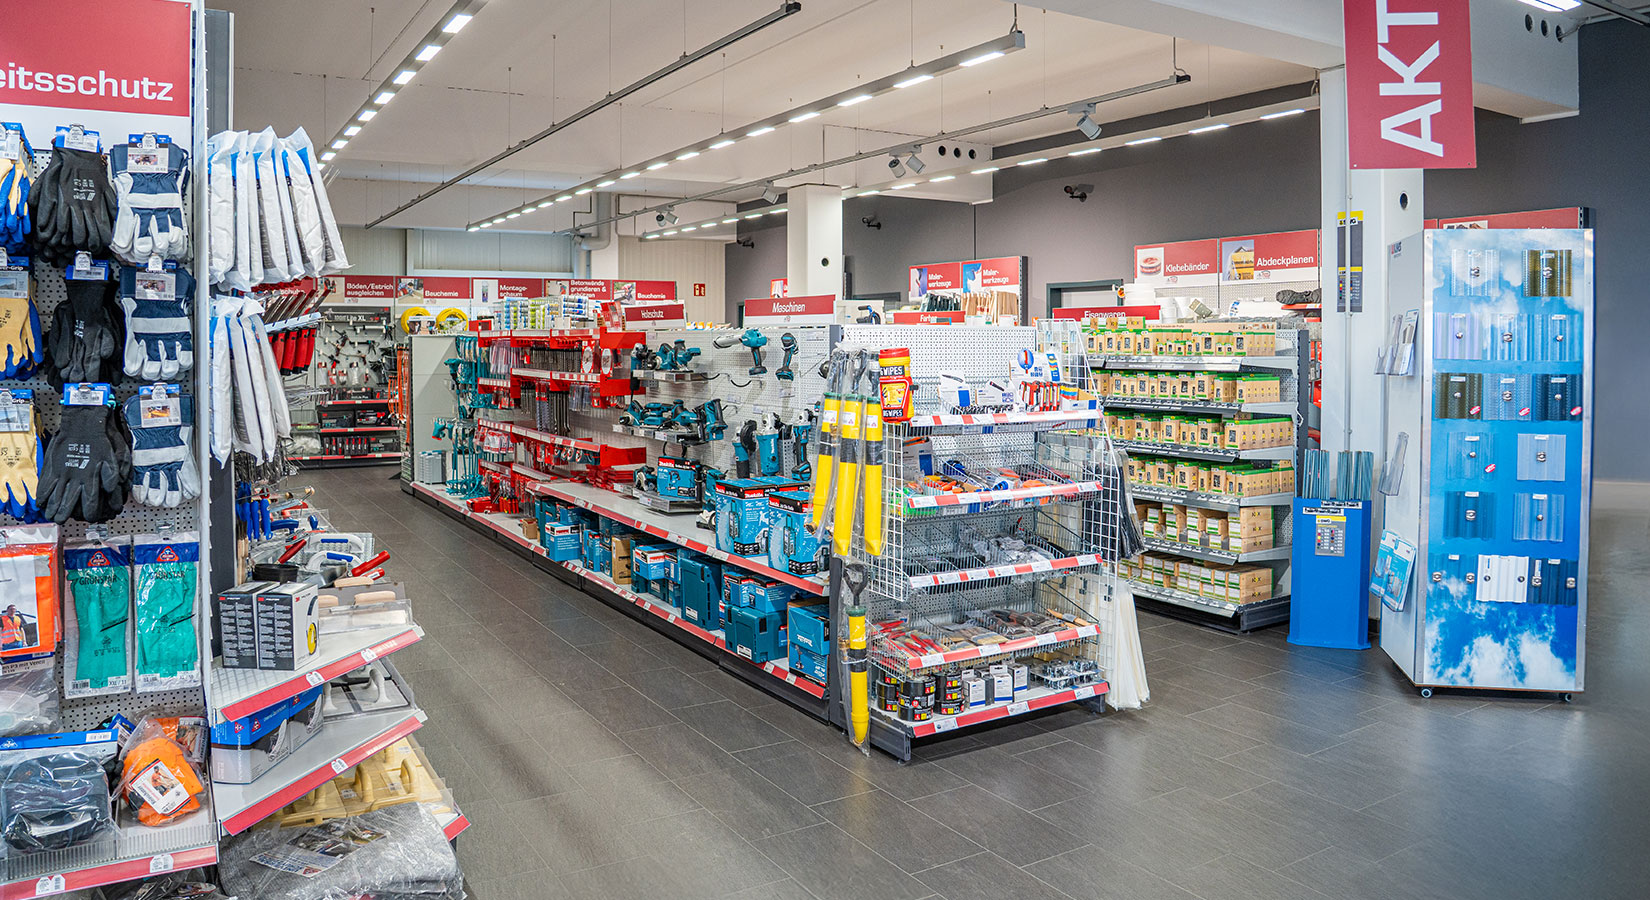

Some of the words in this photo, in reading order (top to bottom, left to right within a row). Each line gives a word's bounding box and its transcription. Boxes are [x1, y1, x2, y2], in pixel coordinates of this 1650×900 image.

[1376, 0, 1444, 158] AKT
[1165, 261, 1210, 273] Klebebänder
[1256, 254, 1314, 268] Abdeckplanen
[346, 282, 393, 290] Böden/Estrich
[346, 289, 385, 297] ausgleichen
[771, 301, 806, 313] Maschinen
